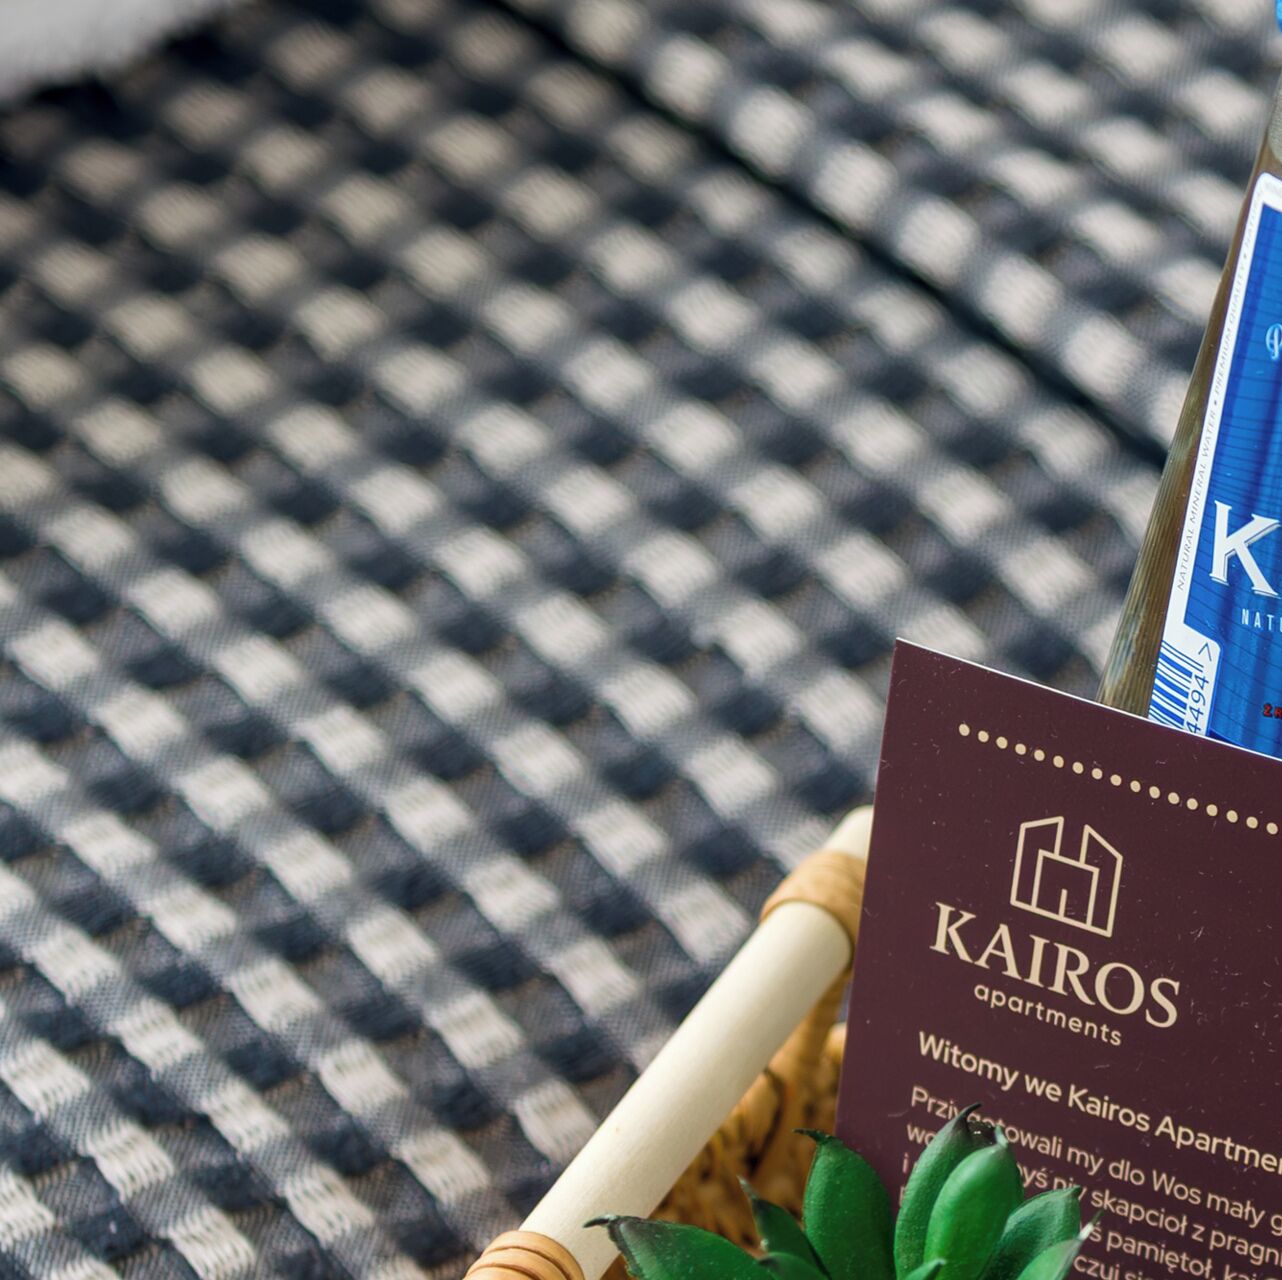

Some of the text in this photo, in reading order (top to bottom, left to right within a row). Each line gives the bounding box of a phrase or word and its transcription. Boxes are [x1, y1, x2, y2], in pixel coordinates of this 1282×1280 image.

[929, 901, 1180, 1029] KAIROS
[973, 984, 1123, 1047] apartments
[919, 1030, 1019, 1093] Witomy
[1023, 1069, 1063, 1103] we
[1067, 1082, 1151, 1133] Kairos
[1067, 1146, 1104, 1176] my
[1108, 1158, 1146, 1187] dlo
[1152, 1169, 1203, 1205] Wos
[1206, 1192, 1266, 1226] mały
[1091, 1190, 1186, 1236] skapcioł
[1191, 1224, 1204, 1242] z
